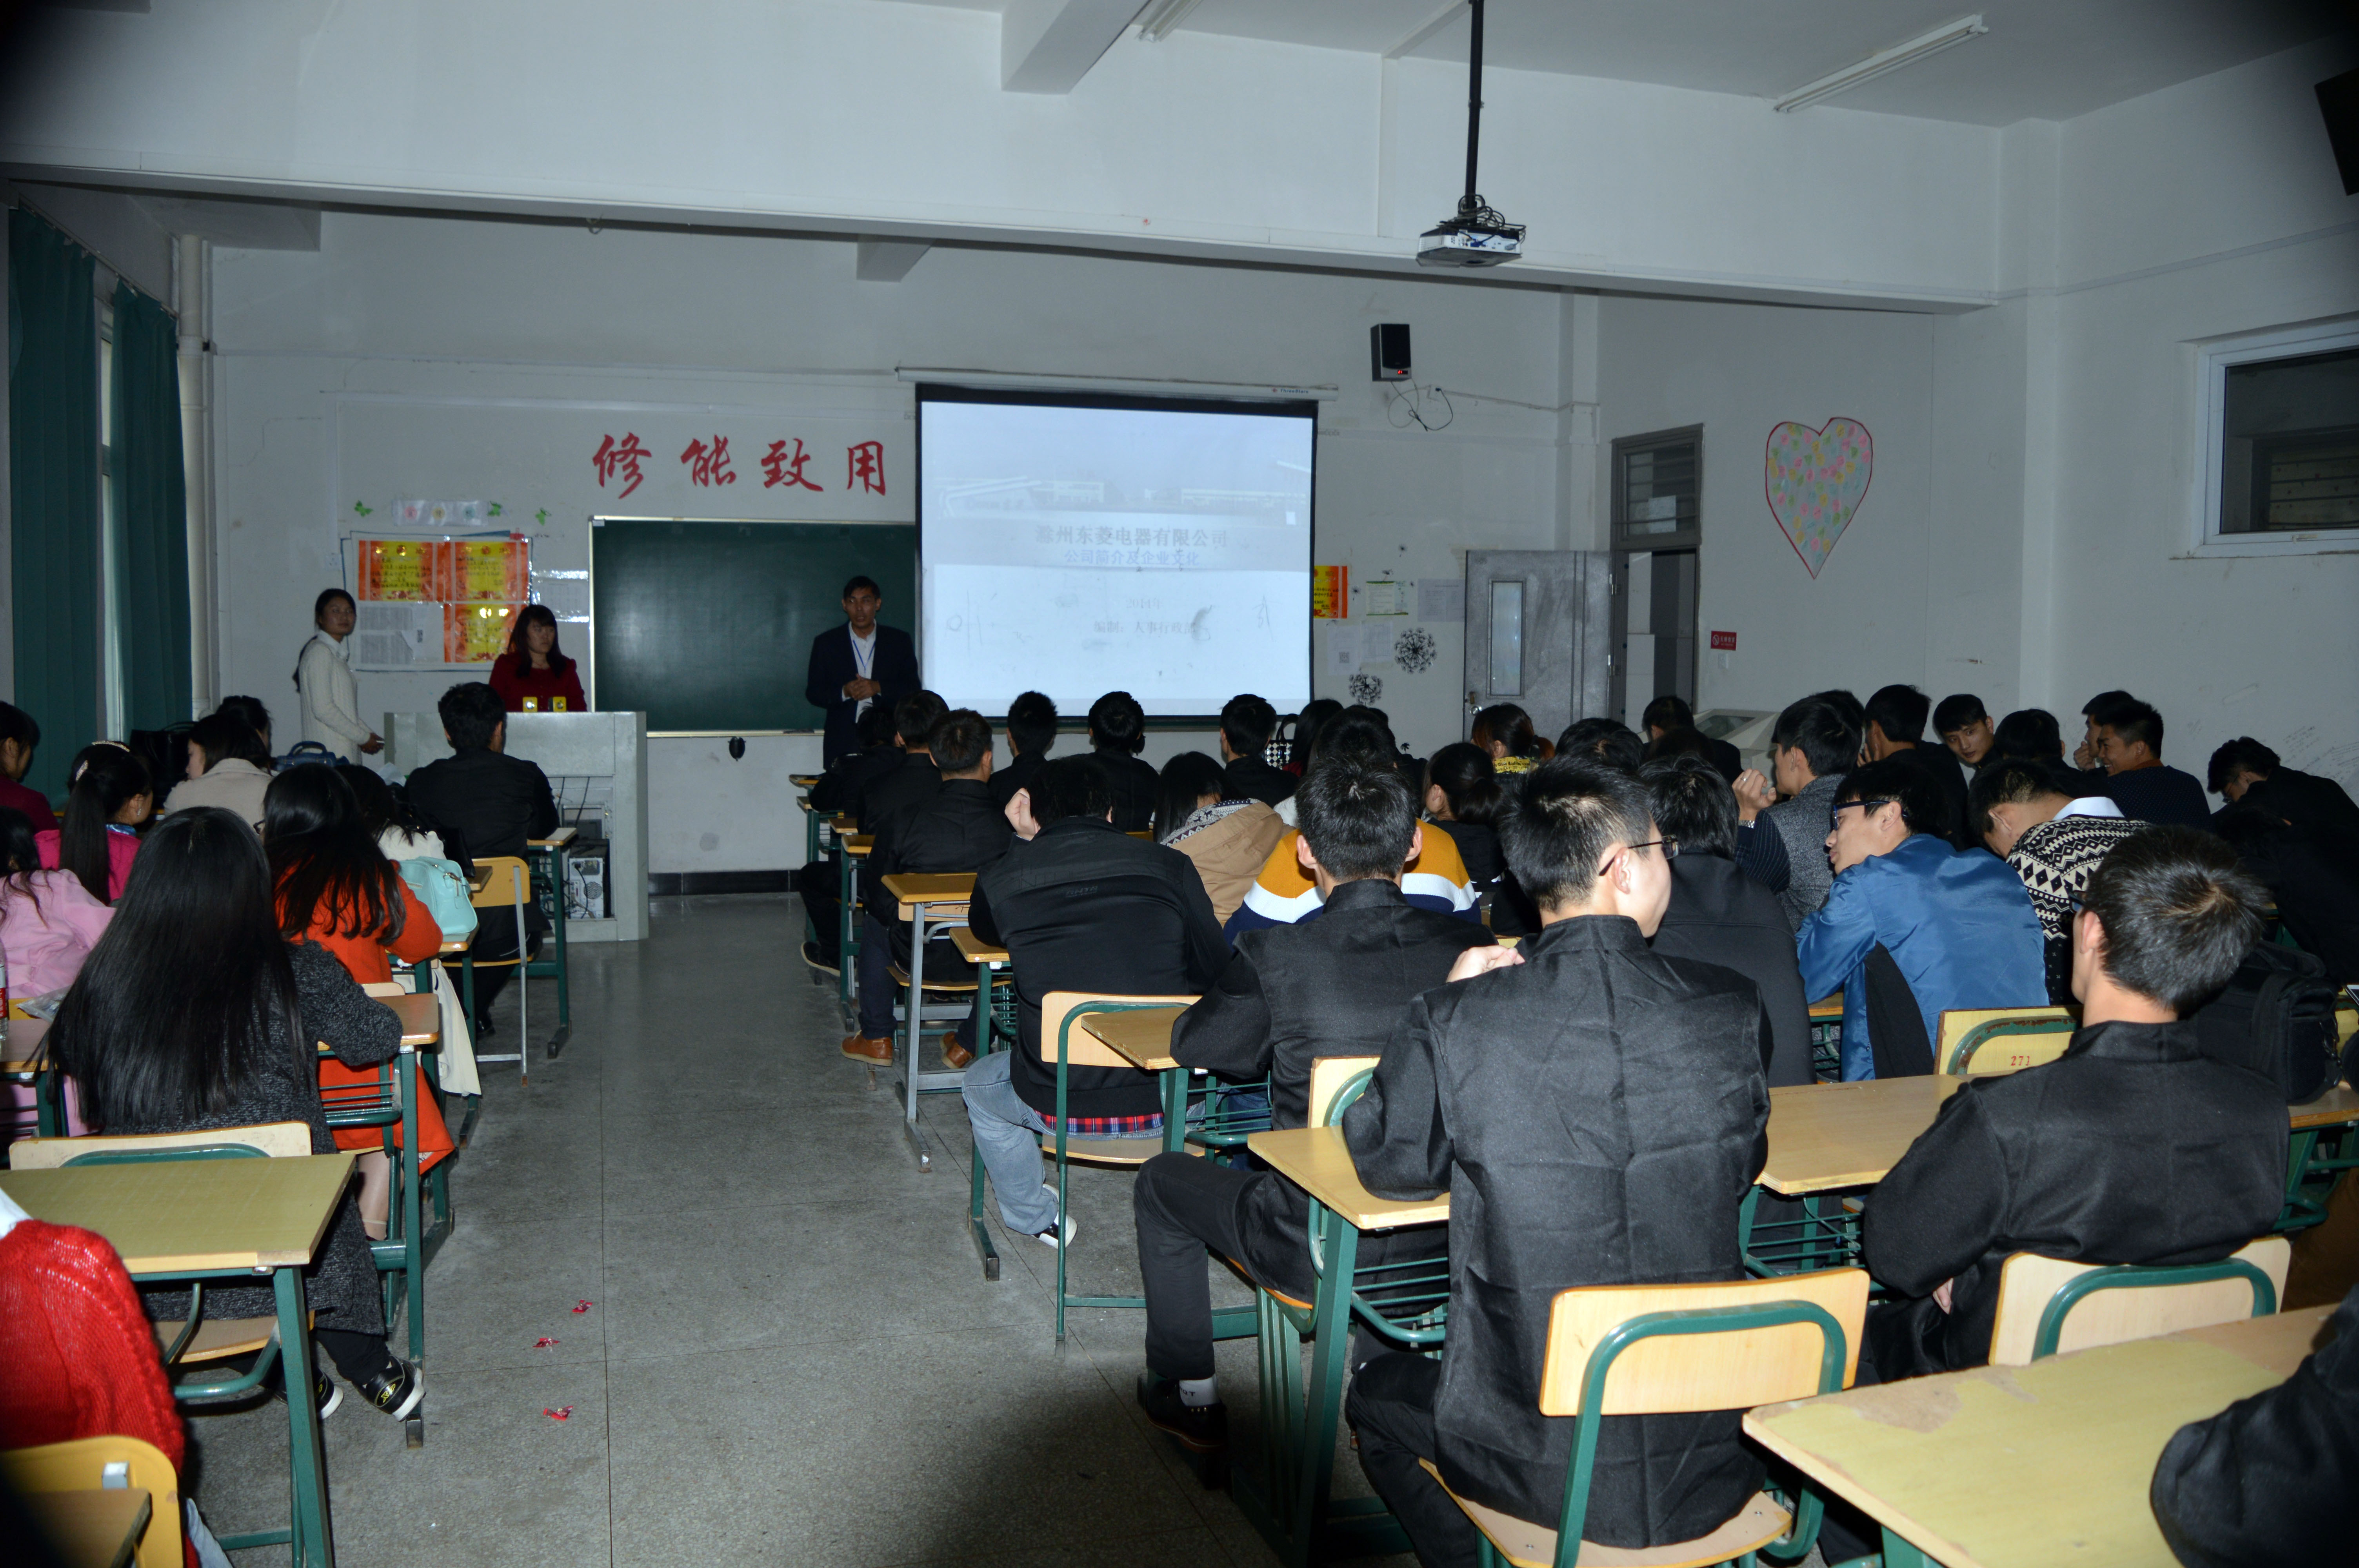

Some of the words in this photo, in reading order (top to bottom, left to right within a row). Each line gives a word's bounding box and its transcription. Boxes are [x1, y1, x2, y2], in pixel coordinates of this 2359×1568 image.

[593, 432, 886, 499] 修能致用
[1035, 525, 1228, 547] 滁州东菱电器有限公司
[1064, 550, 1200, 566] 公司简介及企业文化
[2011, 1056, 2030, 1066] 271
